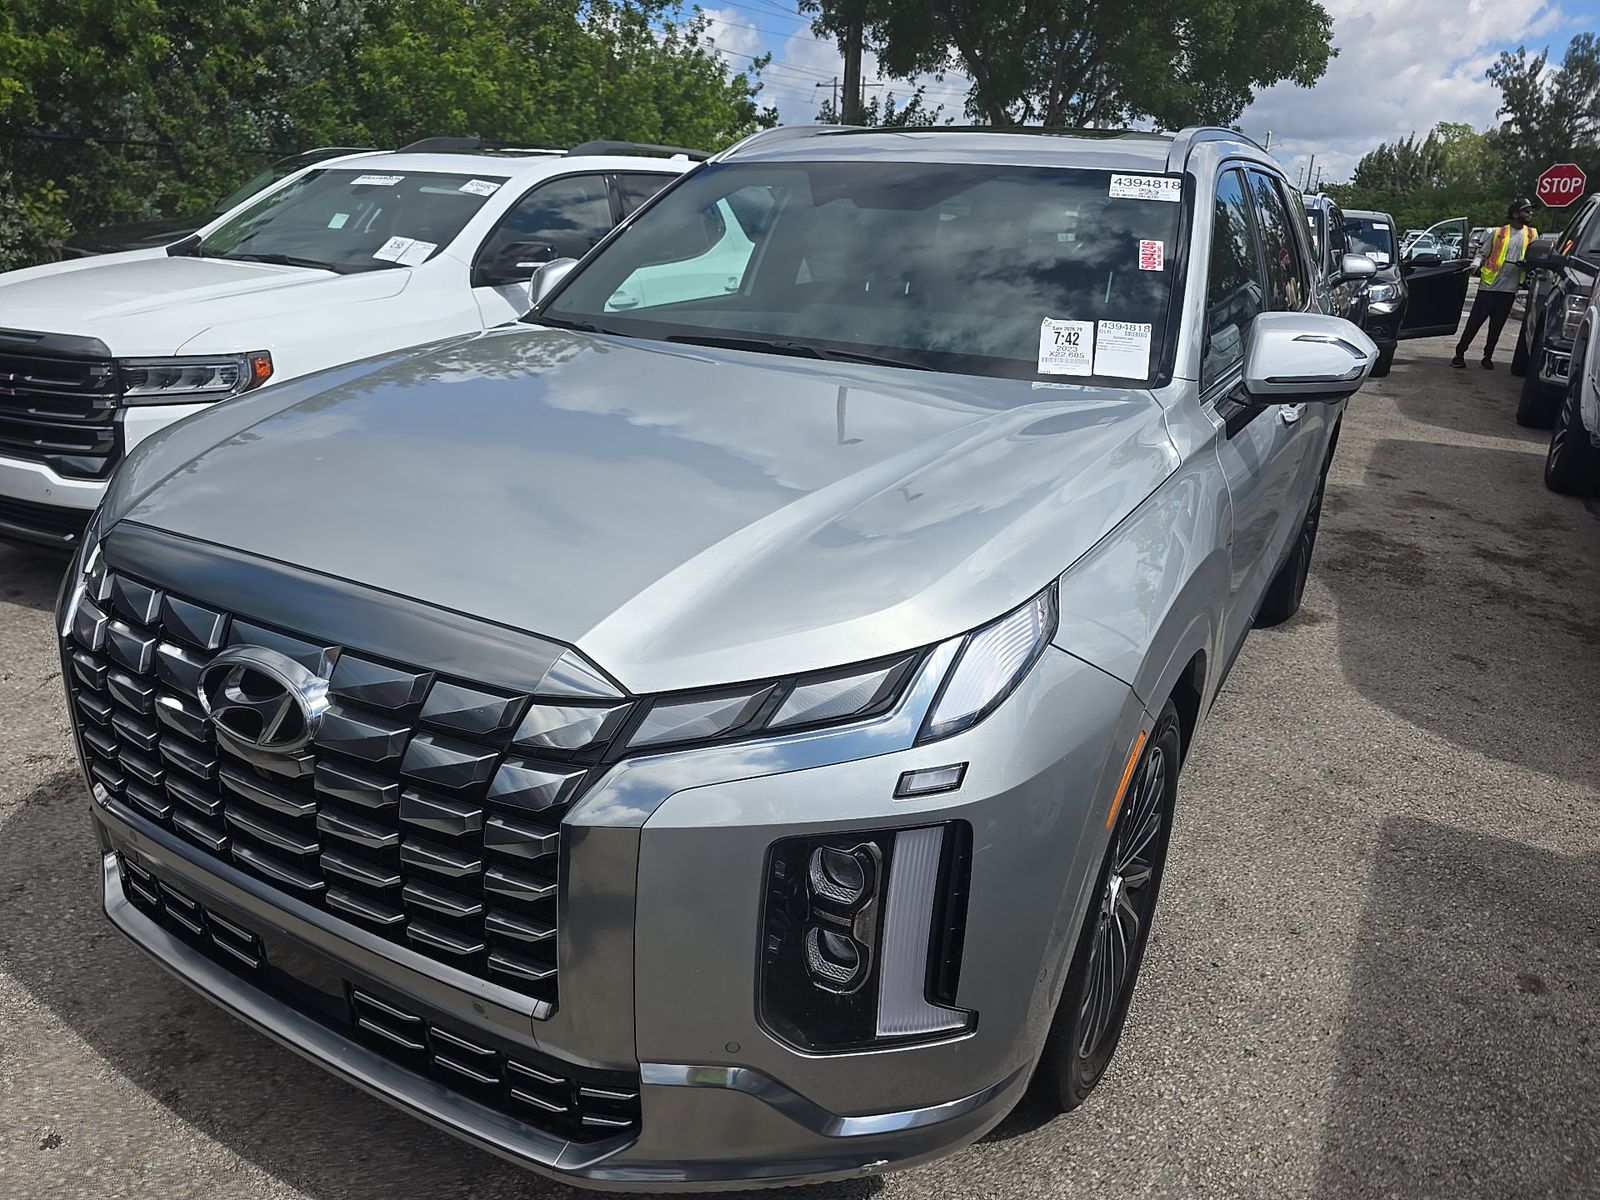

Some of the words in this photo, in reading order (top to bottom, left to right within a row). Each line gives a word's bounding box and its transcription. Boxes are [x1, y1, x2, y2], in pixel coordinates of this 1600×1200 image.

[1114, 177, 1181, 190] 4394818
[1541, 177, 1582, 193] STOP
[1101, 322, 1151, 333] 4394818
[1054, 331, 1080, 346] 7:42
